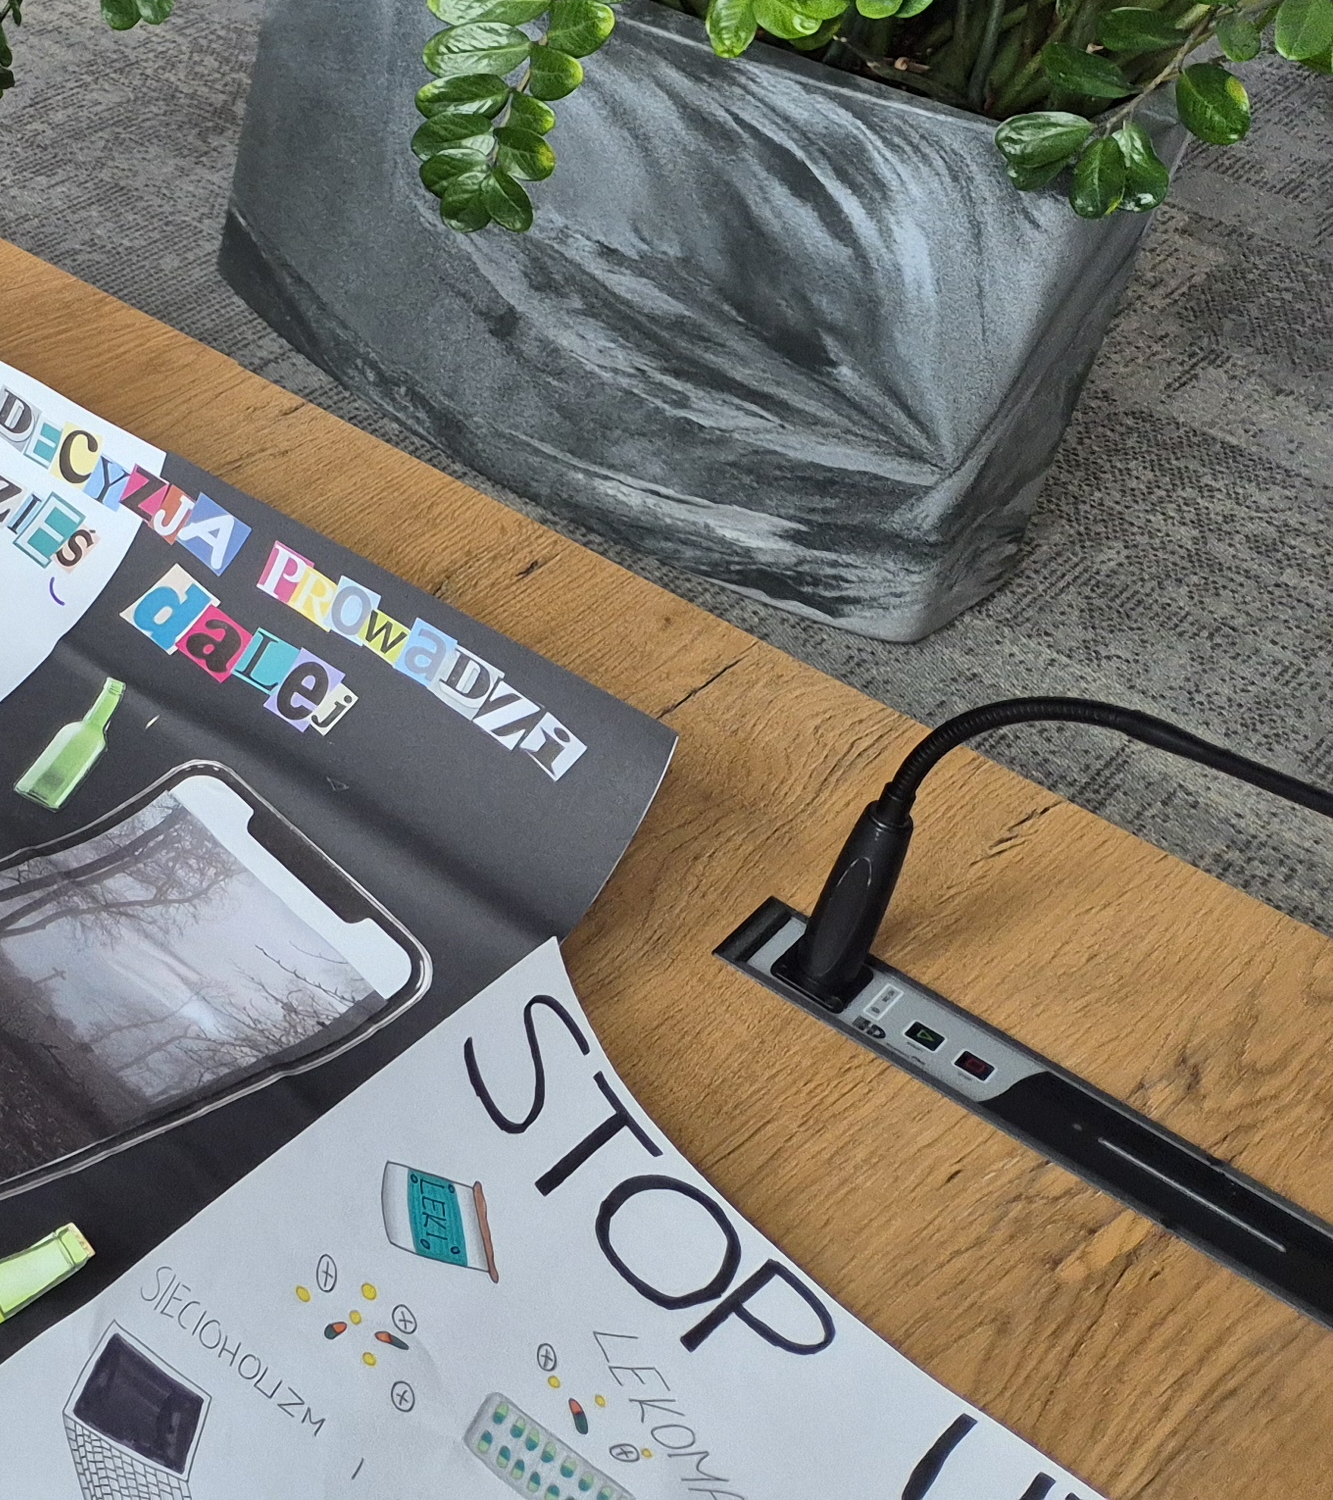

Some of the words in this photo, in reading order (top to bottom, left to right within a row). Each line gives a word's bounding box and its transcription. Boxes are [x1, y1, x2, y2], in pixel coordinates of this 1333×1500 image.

[419, 1178, 449, 1241] LEKI
[463, 993, 836, 1354] STOP
[139, 1265, 327, 1438] SIECIOHOLIZM
